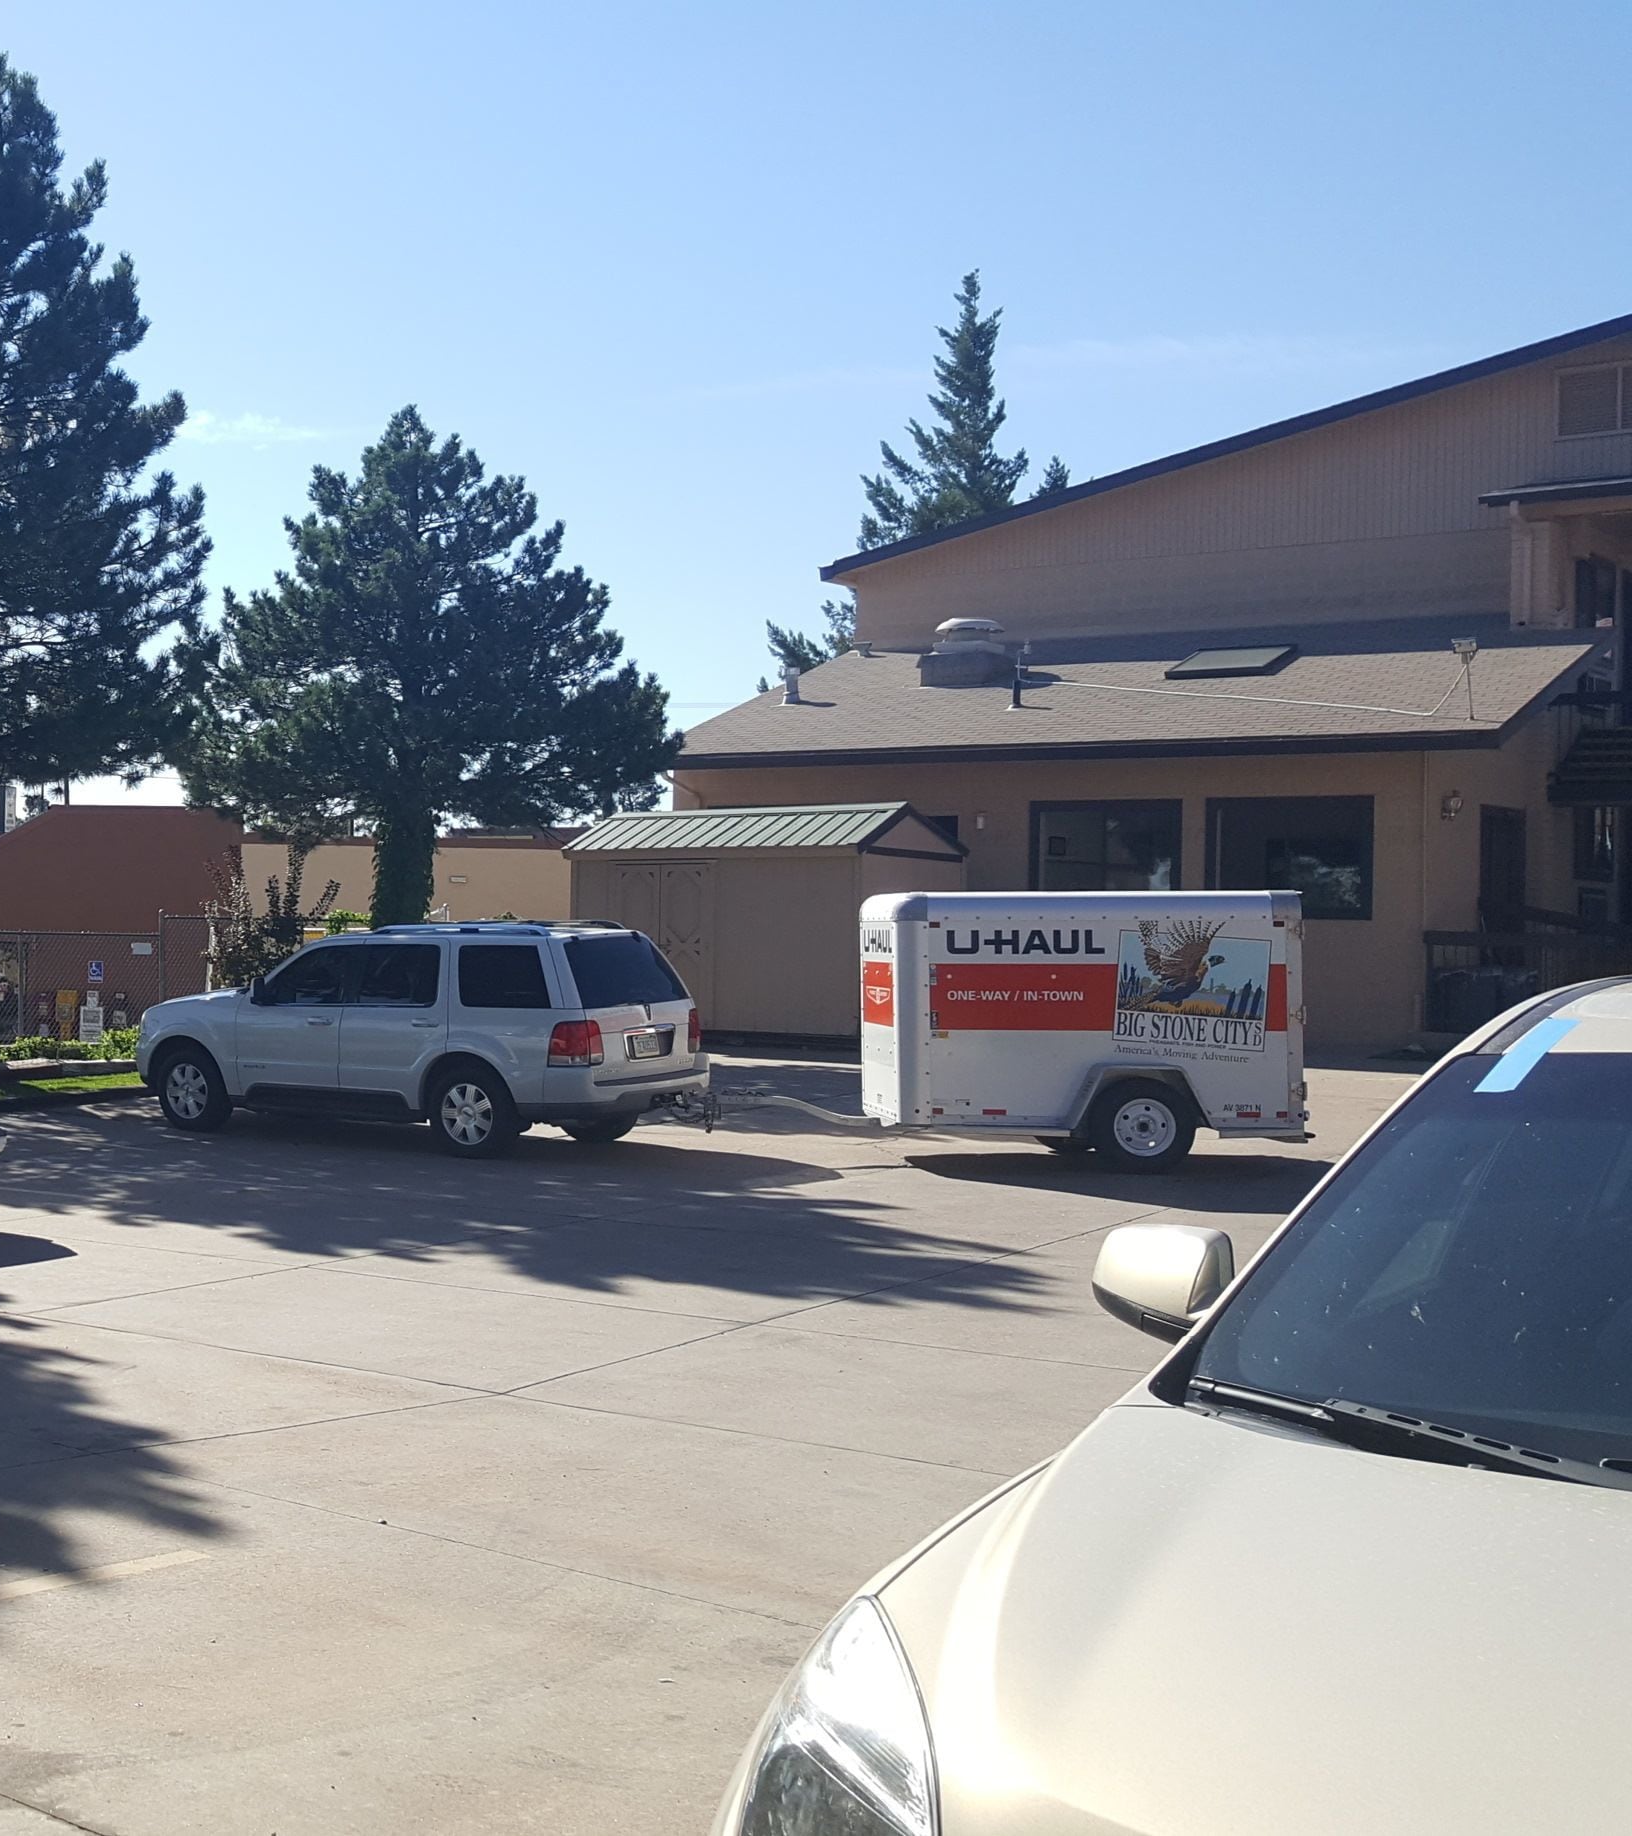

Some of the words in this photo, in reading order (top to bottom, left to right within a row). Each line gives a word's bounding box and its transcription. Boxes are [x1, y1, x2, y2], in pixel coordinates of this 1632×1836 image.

[864, 929, 893, 953] U-HAUL
[946, 929, 1106, 955] U-HAUL
[947, 990, 1011, 1001] ONE-WAY
[1023, 990, 1084, 1001] IN-TOWN
[1115, 1011, 1146, 1038] BIG
[1150, 1014, 1208, 1043] STONE
[1212, 1018, 1254, 1046] CITY
[1113, 1044, 1159, 1056] America's
[1162, 1047, 1198, 1060] Moving
[1201, 1050, 1251, 1063] Adventure
[1223, 1103, 1234, 1112] AV
